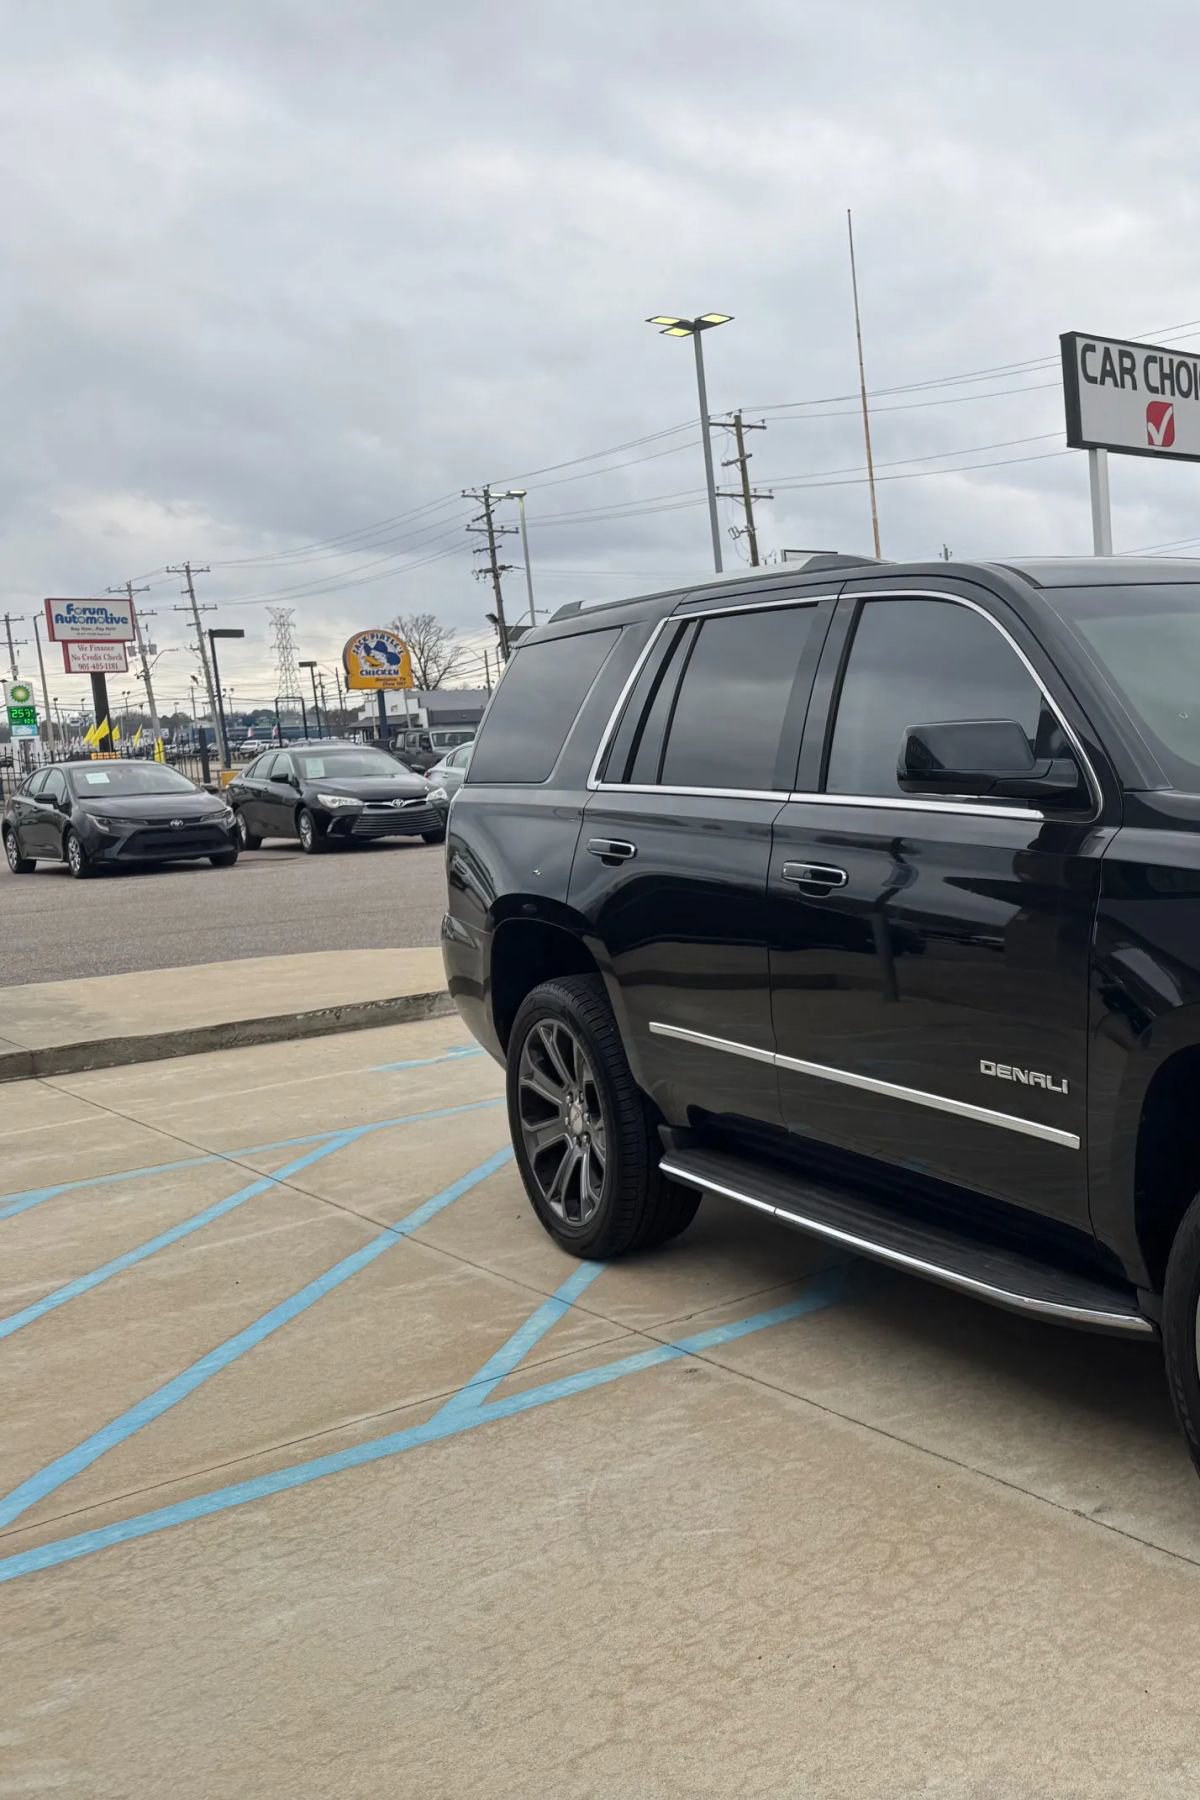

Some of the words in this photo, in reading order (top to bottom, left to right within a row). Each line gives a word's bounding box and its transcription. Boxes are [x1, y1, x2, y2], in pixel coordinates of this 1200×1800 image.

[1081, 343, 1138, 391] CAR
[66, 603, 108, 616] Forum
[55, 613, 129, 625] Automotive
[77, 644, 88, 652] We
[89, 644, 115, 652] Finance
[980, 1059, 1068, 1094] DENALI
